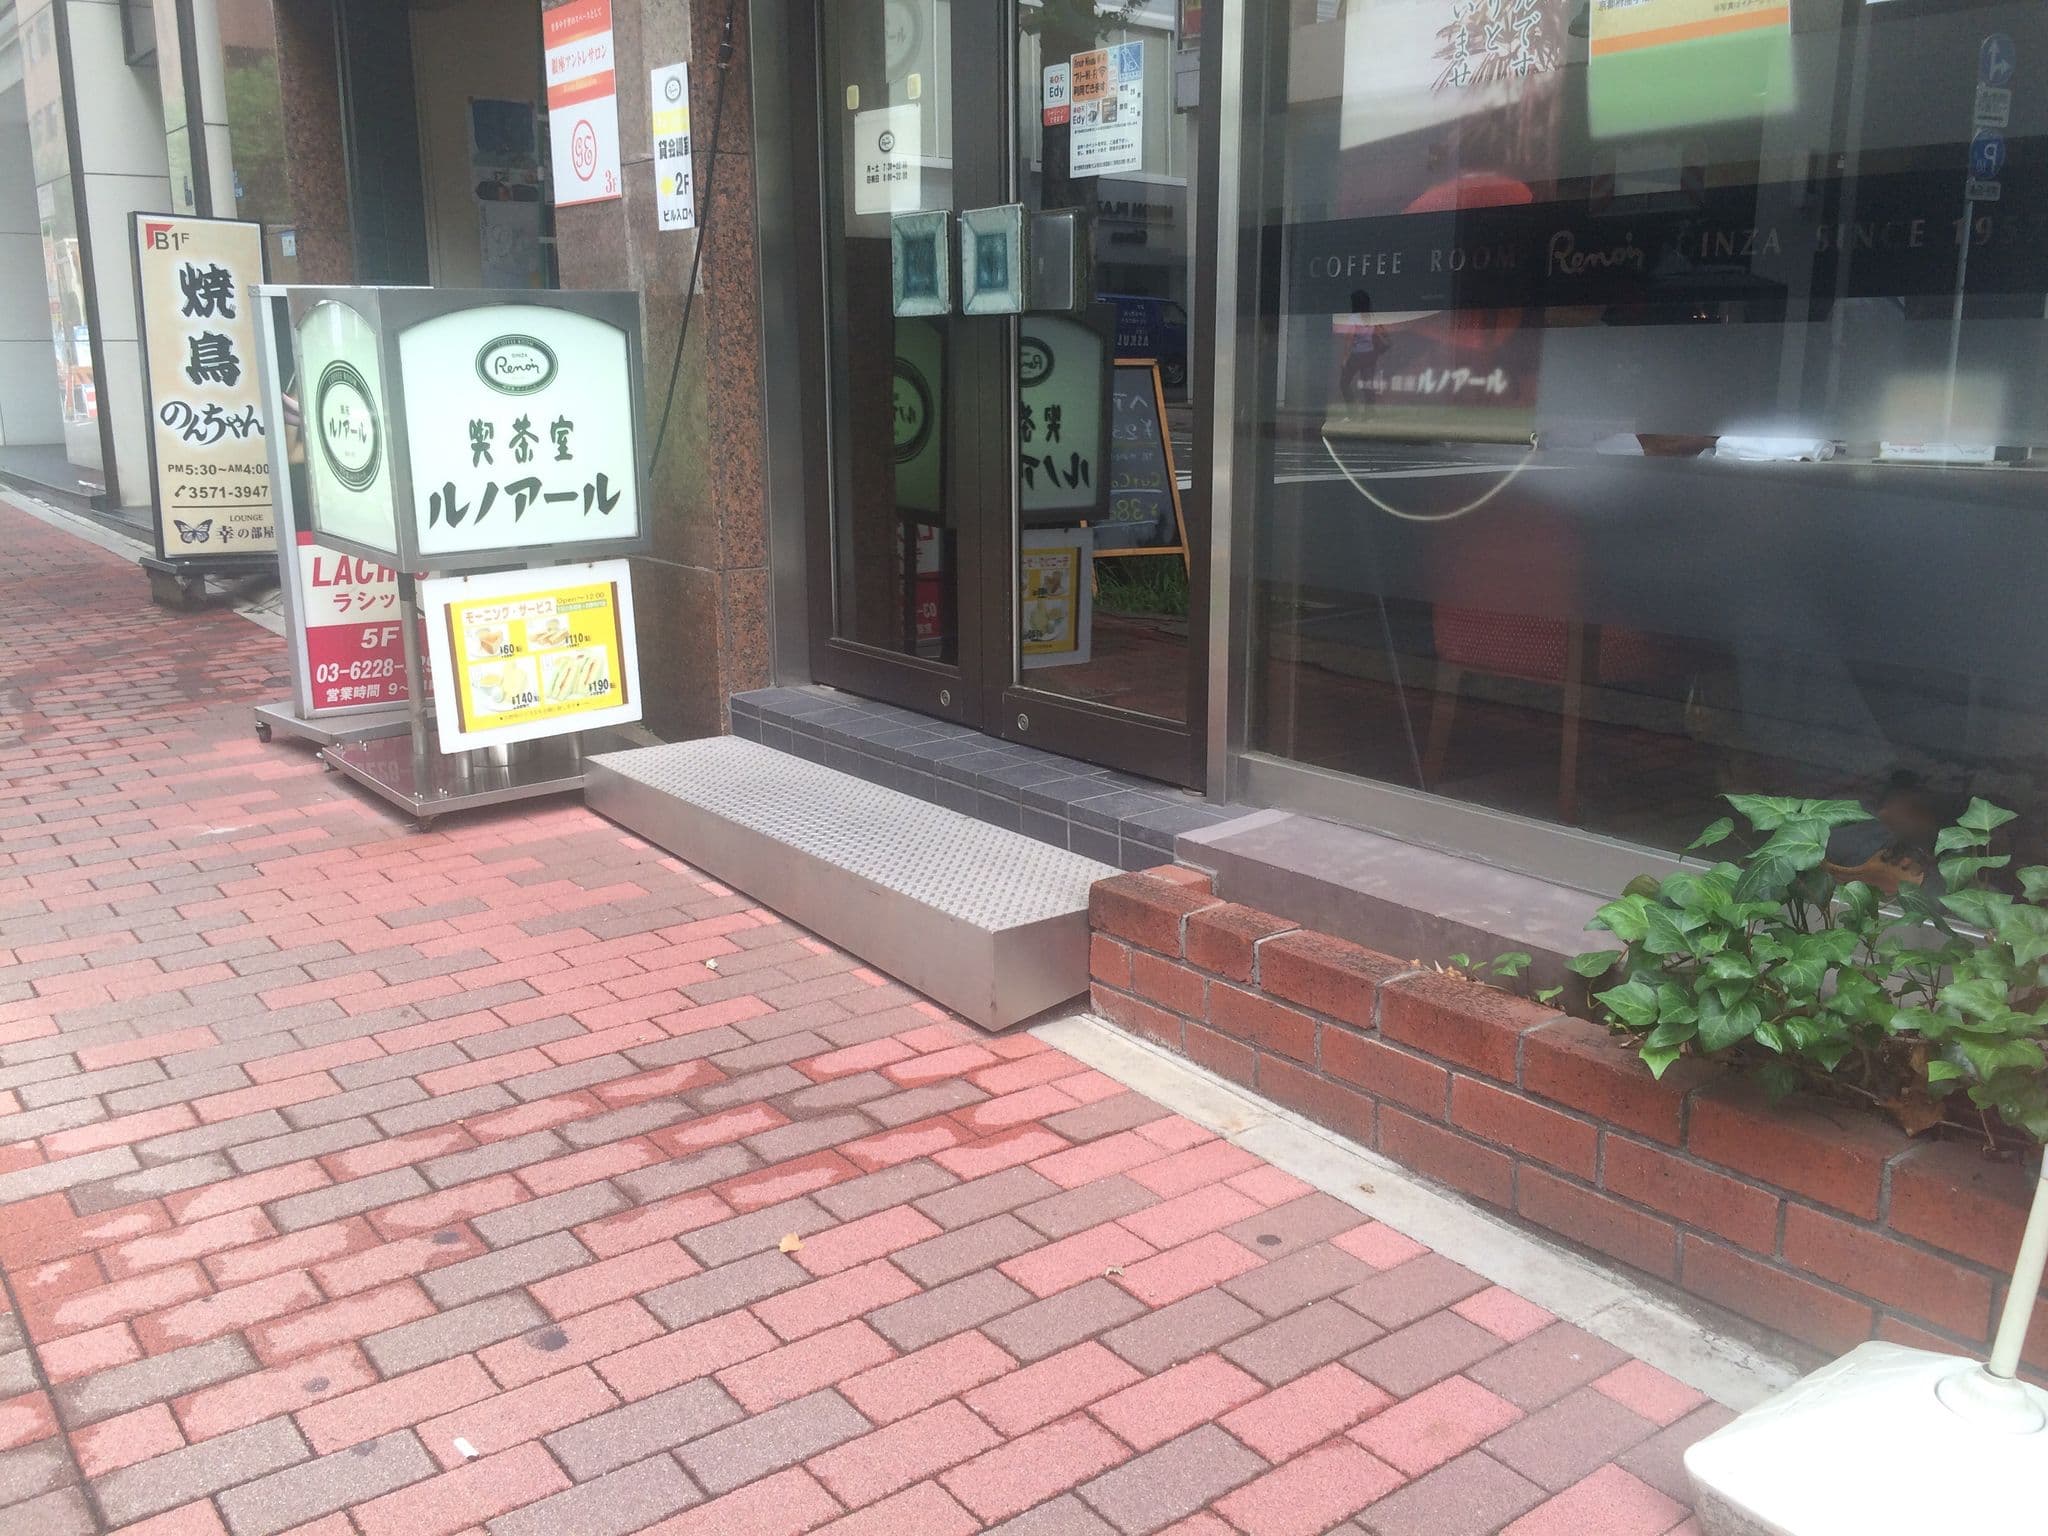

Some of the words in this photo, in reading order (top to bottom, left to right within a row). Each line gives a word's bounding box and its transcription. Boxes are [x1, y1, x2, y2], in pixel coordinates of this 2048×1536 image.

[1049, 85, 1065, 98] Edy
[1072, 114, 1085, 125] Edy
[605, 170, 616, 194] 3F
[675, 172, 689, 196] 2F
[155, 231, 190, 251] B1F
[1309, 252, 1402, 278] COFFEE
[1430, 247, 1518, 273] ROOM
[1816, 219, 1925, 253] SINE
[178, 262, 242, 387] 焼鳥
[494, 356, 540, 375] Renoir
[160, 400, 266, 446] のんちゃん
[329, 417, 367, 444] ルノアール
[469, 412, 574, 468] 喫茶室
[188, 486, 268, 499] 3571-3947
[429, 472, 621, 530] ルノアール
[229, 514, 263, 522] LOUNGE
[217, 525, 274, 543] 幸の部屋
[465, 601, 553, 625] モーニング・サービス
[361, 627, 400, 649] 5F
[326, 684, 381, 703] 営業時間
